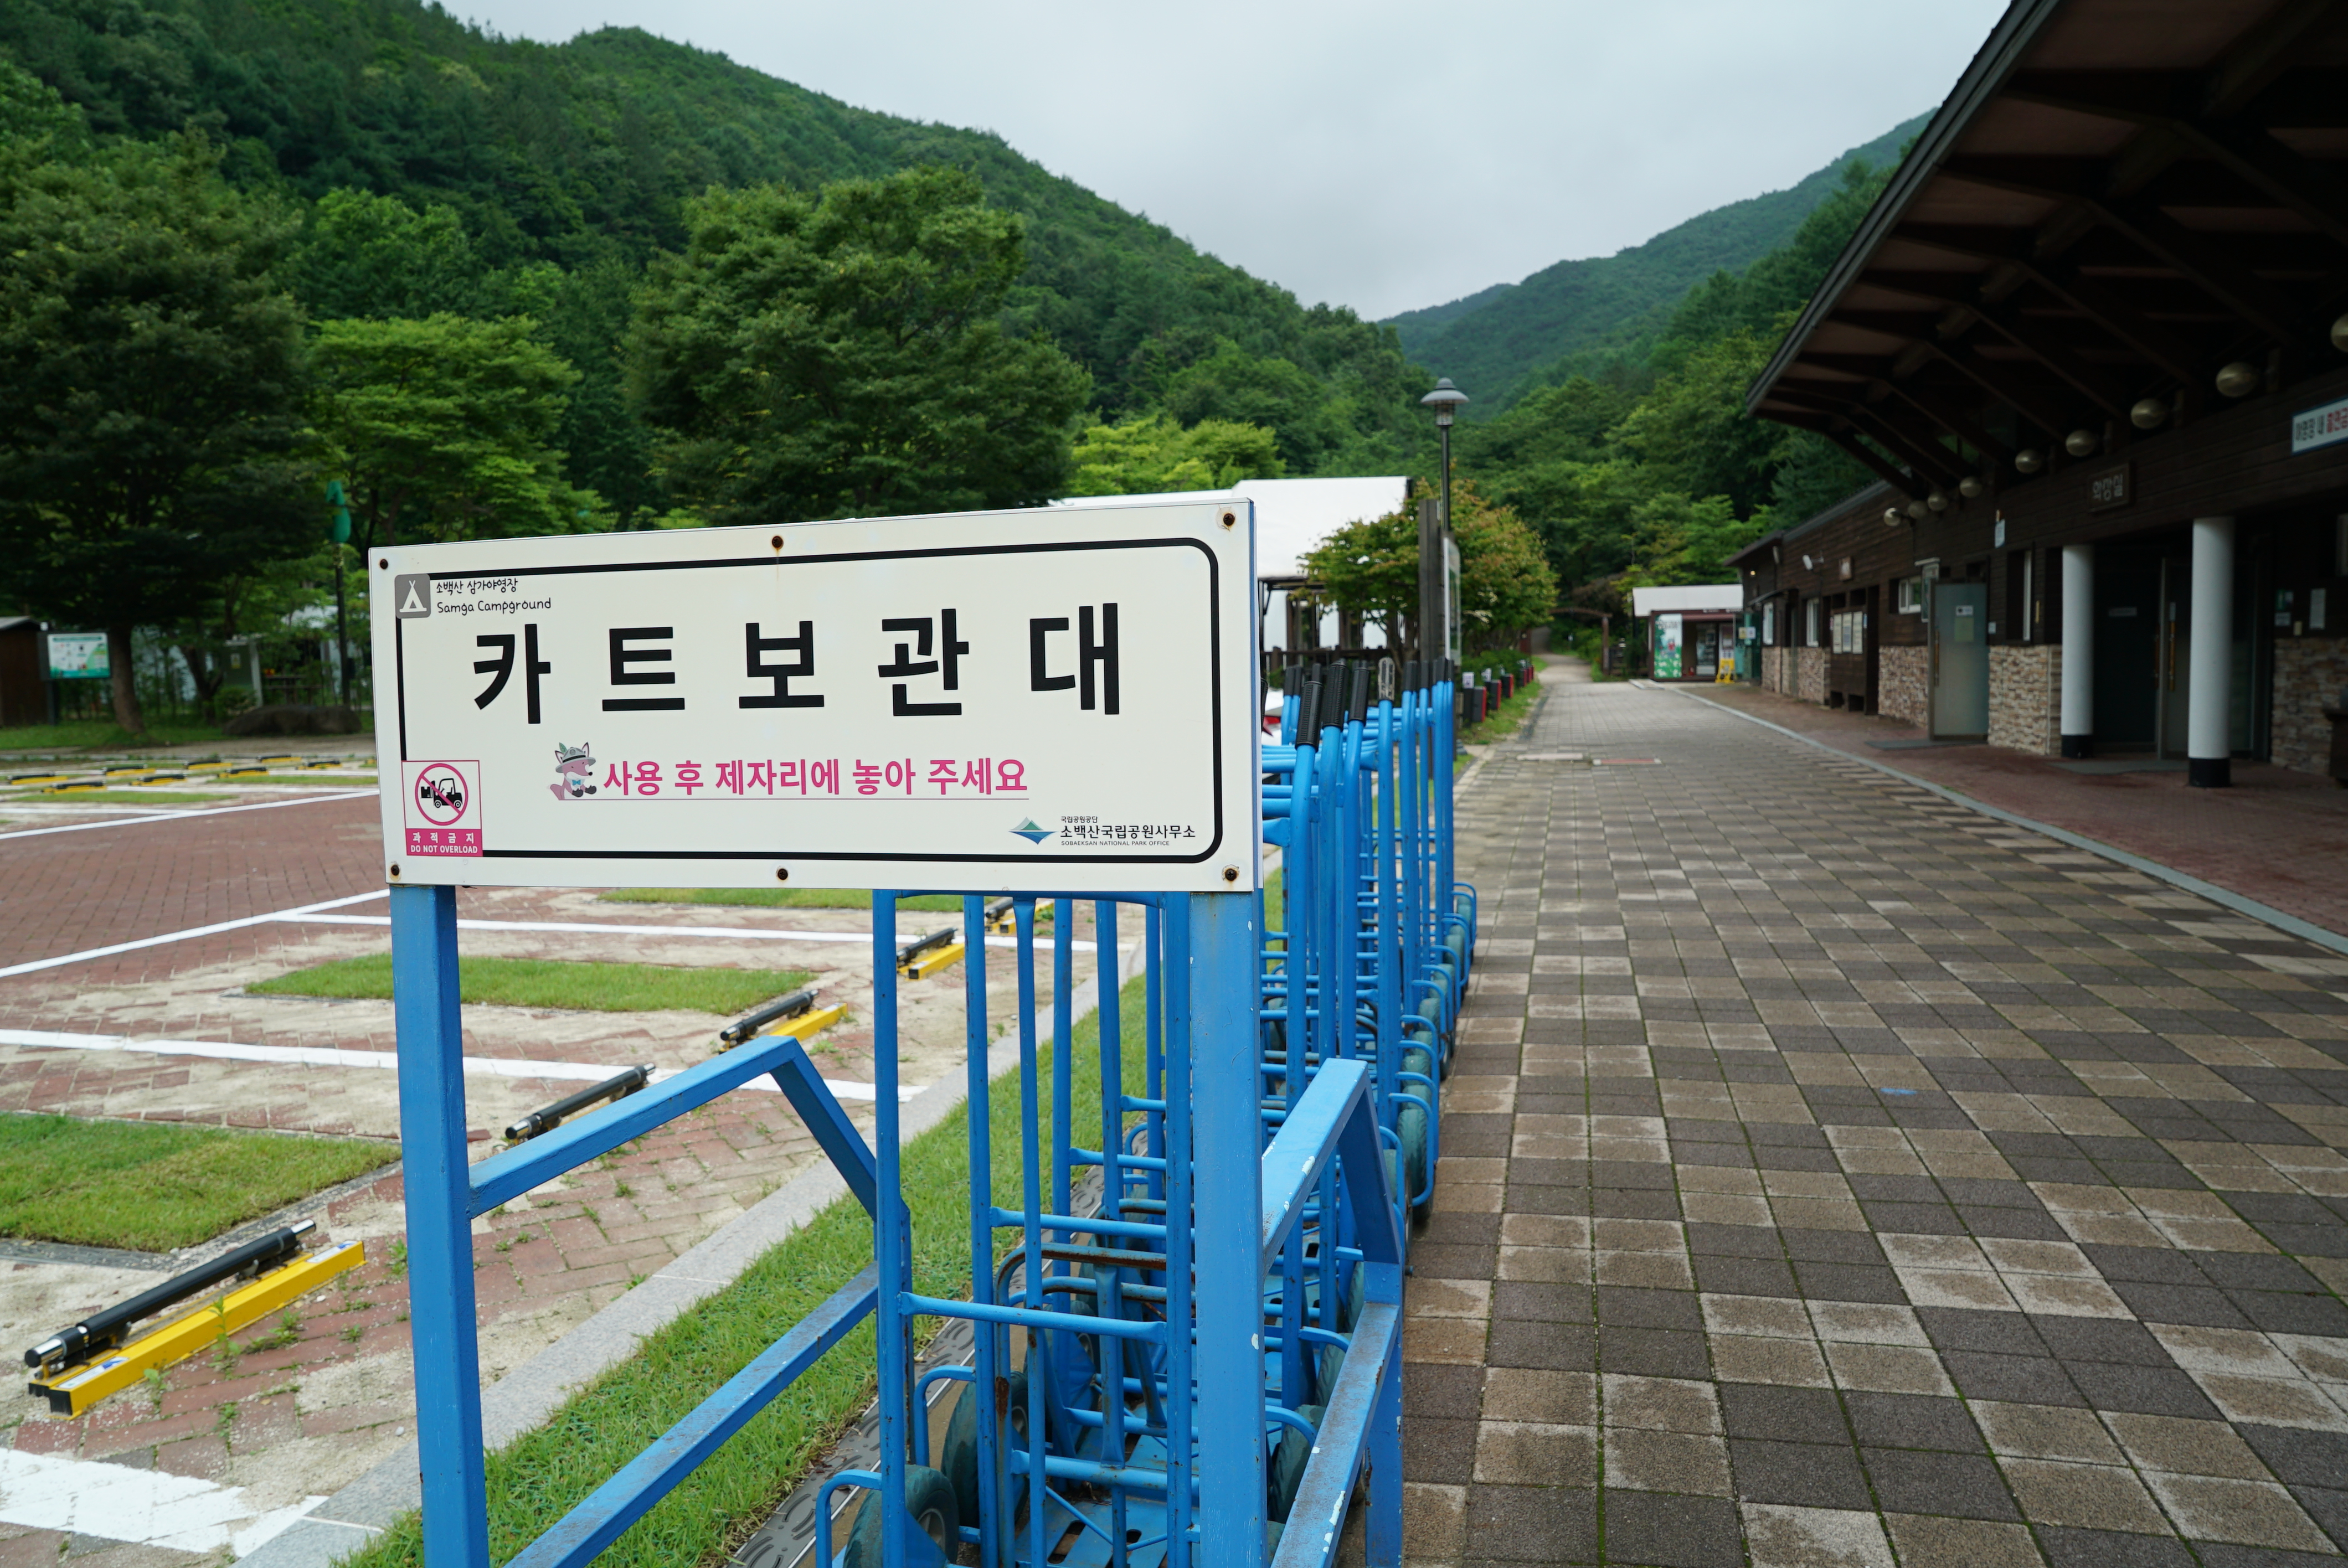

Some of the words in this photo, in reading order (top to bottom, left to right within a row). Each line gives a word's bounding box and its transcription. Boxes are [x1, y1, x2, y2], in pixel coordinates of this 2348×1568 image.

[436, 580, 464, 596] 소백산
[467, 577, 518, 595] 삼가야영장
[437, 601, 475, 616] Samga
[477, 597, 552, 615] Campground
[604, 760, 663, 796] 사용
[674, 760, 704, 795] 후
[715, 759, 840, 796] 제자리에
[852, 757, 916, 796] 놓아
[927, 757, 1028, 796] 주세요
[1060, 824, 1196, 839] 소백산국립공원사무소
[423, 845, 438, 853] NOT
[440, 845, 478, 854] OVERLOAD
